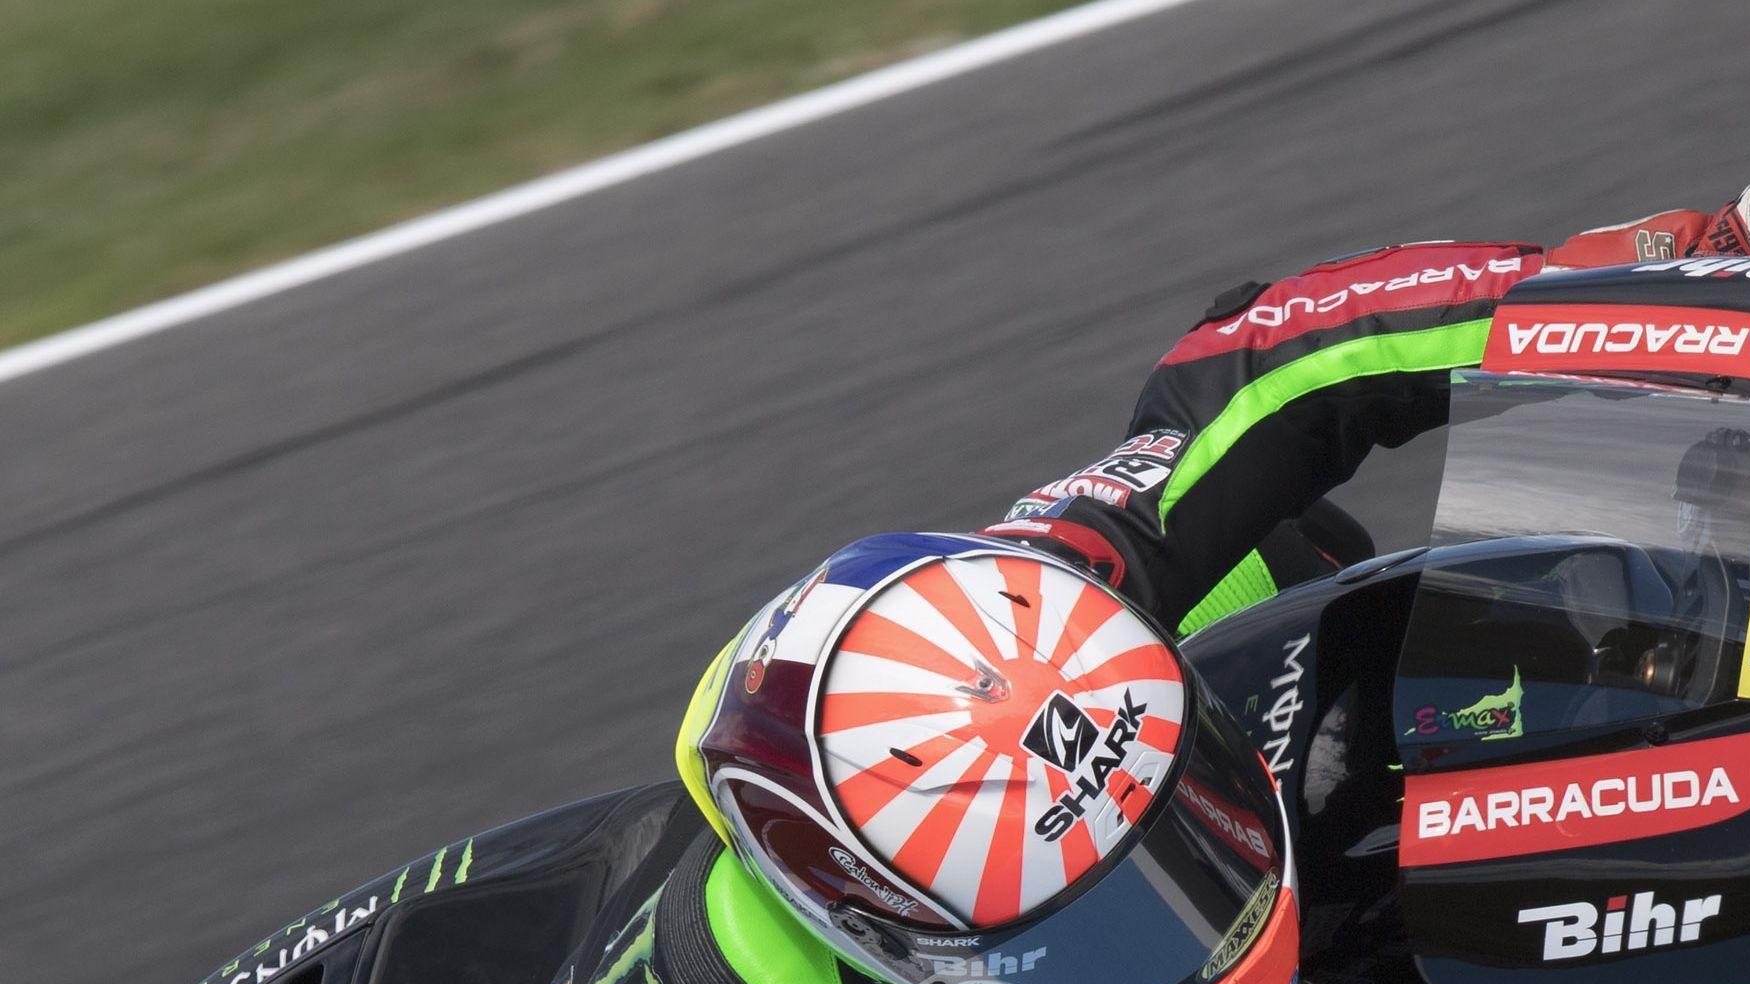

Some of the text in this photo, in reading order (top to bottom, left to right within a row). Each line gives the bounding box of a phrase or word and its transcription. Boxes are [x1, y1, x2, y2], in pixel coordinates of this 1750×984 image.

[1216, 257, 1521, 336] BARRACUDA
[1034, 686, 1148, 842] SHARK
[1417, 766, 1740, 839] BARRACUDA
[915, 945, 1048, 977] Bihr
[916, 936, 982, 948] SHARK
[1517, 891, 1723, 961] Bihr
